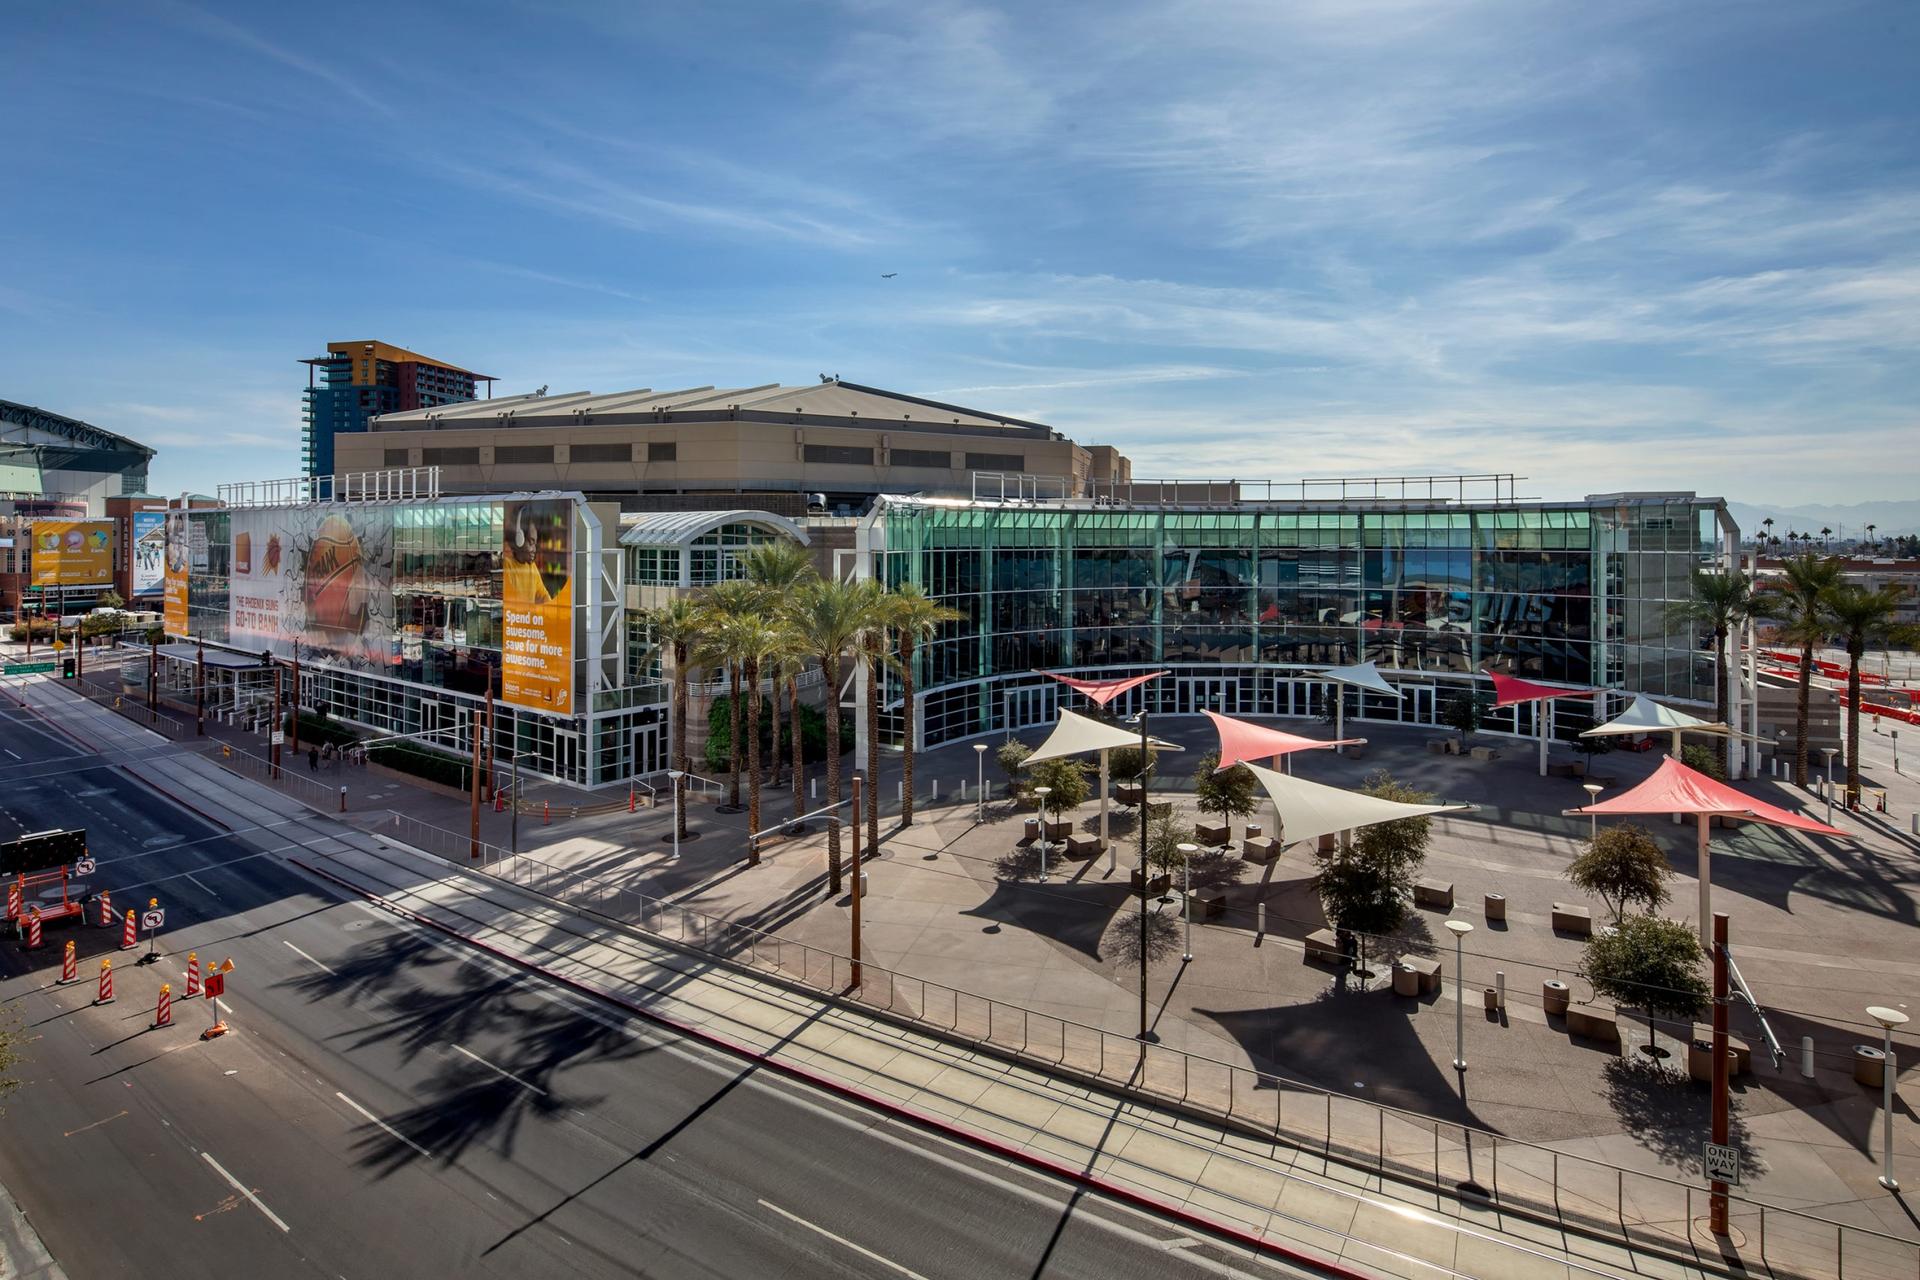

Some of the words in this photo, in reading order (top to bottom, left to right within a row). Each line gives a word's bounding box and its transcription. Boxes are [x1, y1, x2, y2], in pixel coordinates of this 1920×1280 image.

[235, 595, 245, 607] THE
[245, 596, 264, 610] PHOENIX
[265, 599, 279, 611] SUNS
[235, 610, 256, 629] GO-TO
[505, 610, 531, 625] Spend
[532, 615, 544, 626] on
[505, 626, 547, 643] awesome,
[505, 640, 524, 651] save
[526, 640, 538, 653] for
[540, 645, 563, 656] more
[505, 653, 548, 669] awesome.
[1708, 1147, 1735, 1160] ONE
[1708, 1156, 1735, 1171] WAY
